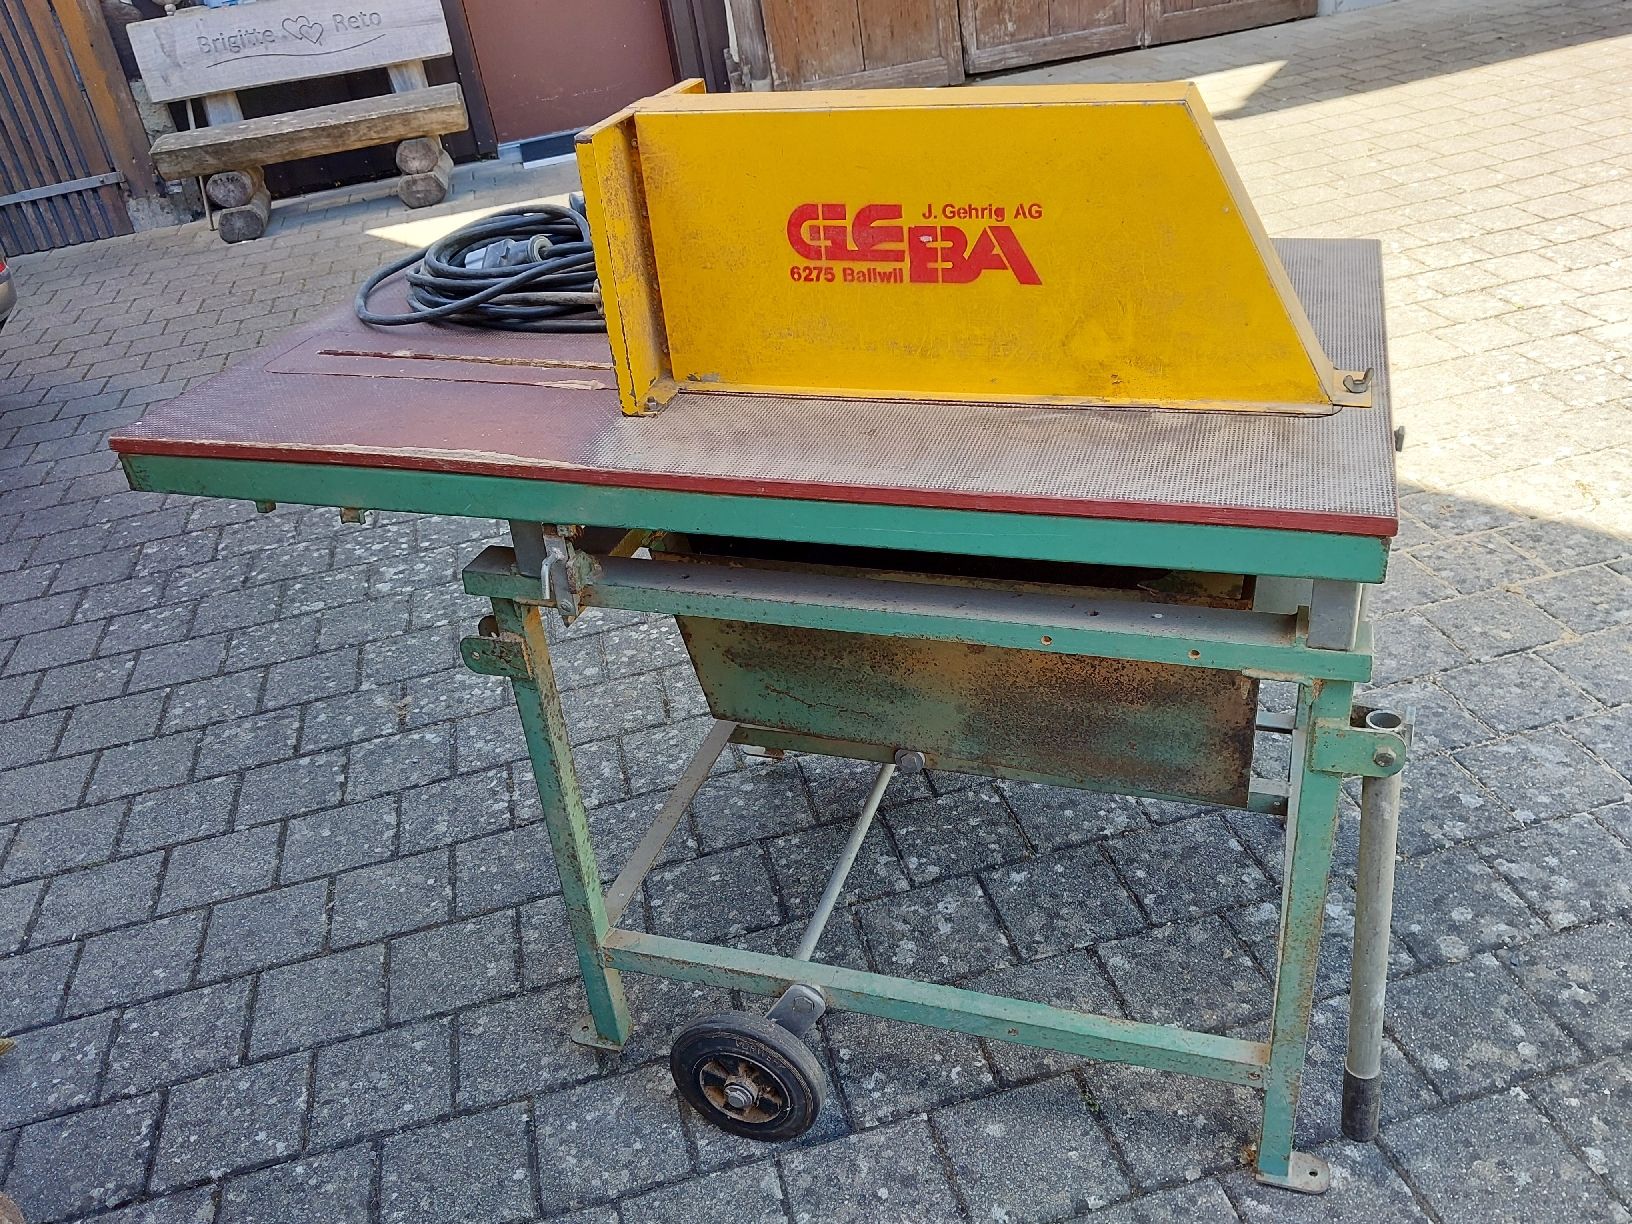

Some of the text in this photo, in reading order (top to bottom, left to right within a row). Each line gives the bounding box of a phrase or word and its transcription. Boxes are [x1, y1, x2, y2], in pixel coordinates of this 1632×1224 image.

[196, 12, 382, 54] Brigitte Reto
[921, 203, 1043, 222] J. Gehrig AG
[789, 265, 904, 284] 6275 Ballwil
